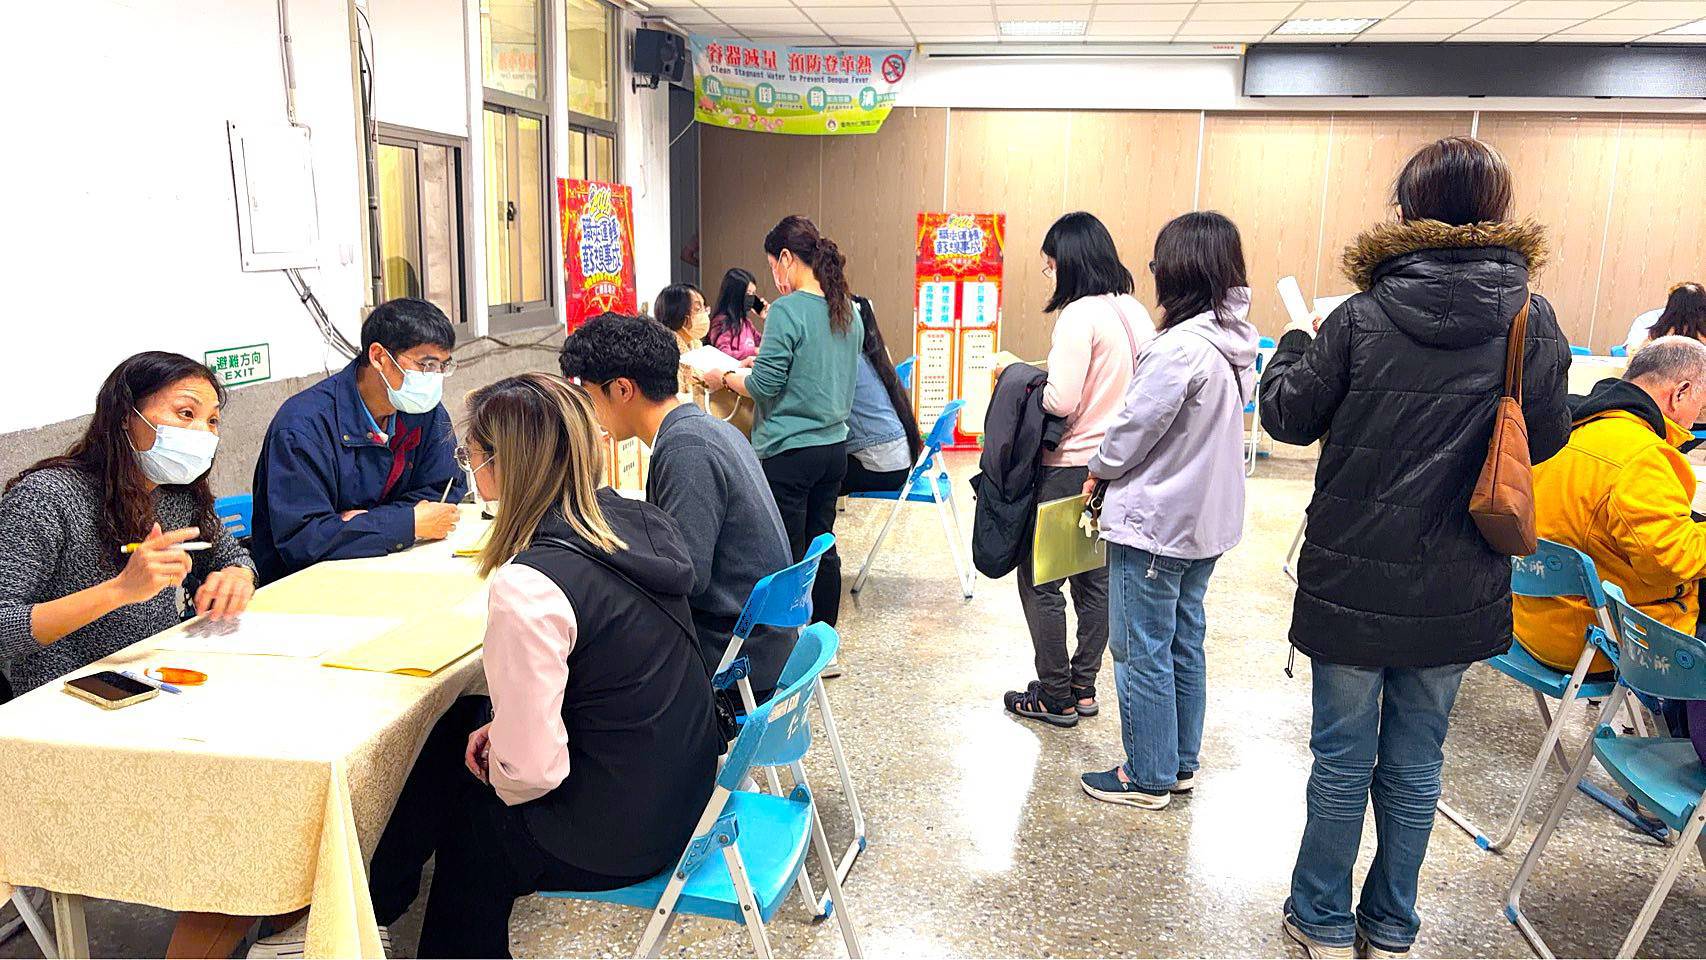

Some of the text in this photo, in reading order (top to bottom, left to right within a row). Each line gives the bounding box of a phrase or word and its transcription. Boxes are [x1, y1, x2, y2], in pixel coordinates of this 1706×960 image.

[707, 43, 872, 75] 容器減量 預防登革熱
[711, 65, 731, 75] Clean
[735, 68, 764, 79] Stagnant
[768, 72, 785, 80] Water
[800, 74, 824, 83] Prevent
[828, 76, 849, 84] Dengue
[216, 351, 261, 370] 避難方向
[225, 367, 255, 380] EXIT
